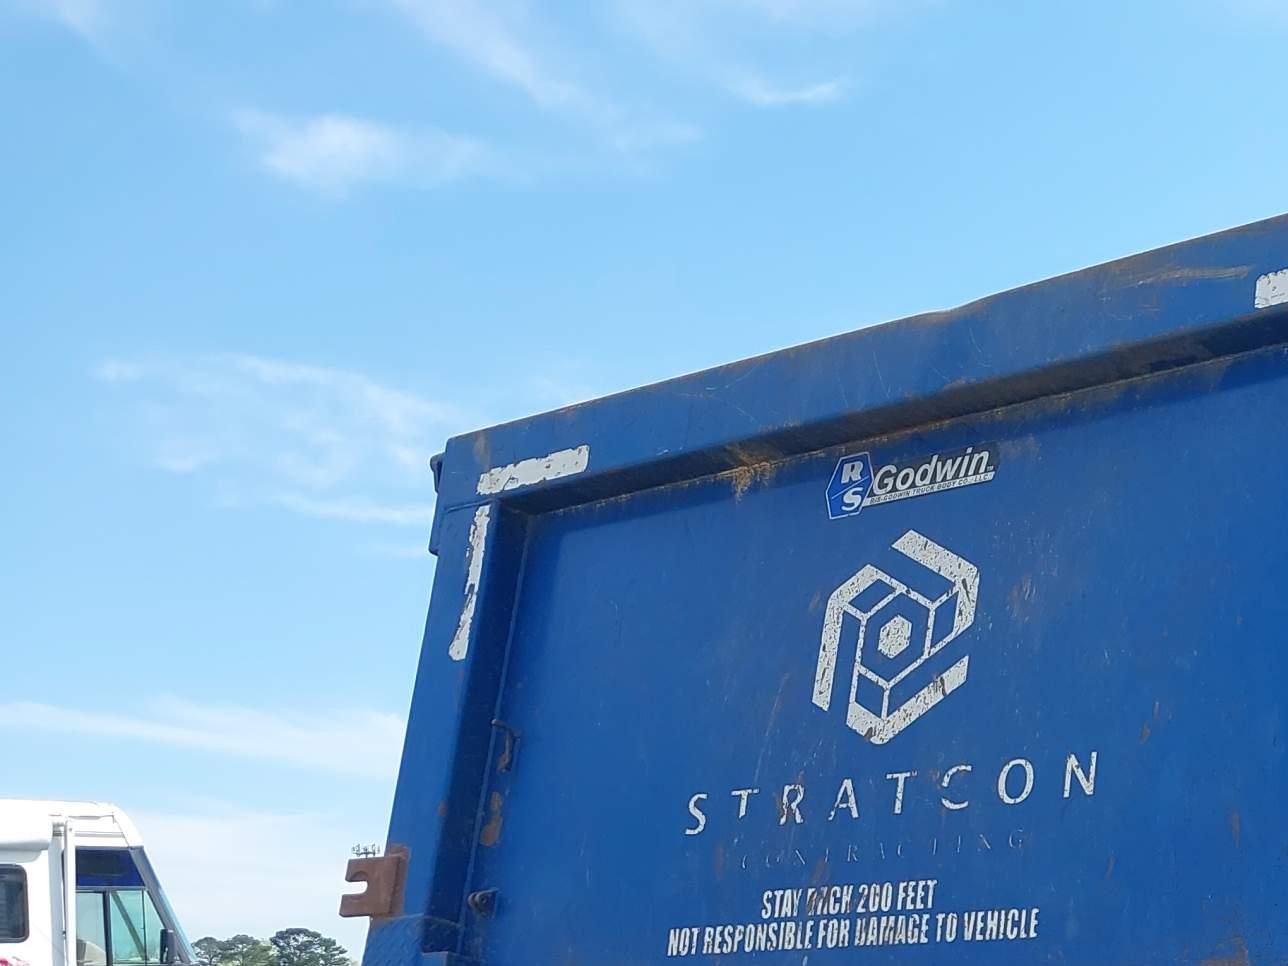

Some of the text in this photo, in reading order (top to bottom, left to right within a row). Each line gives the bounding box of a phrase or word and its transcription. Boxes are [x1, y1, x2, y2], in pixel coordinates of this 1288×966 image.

[841, 461, 864, 484] R
[872, 447, 990, 495] Godwin
[841, 486, 864, 511] S
[685, 752, 1098, 835] STRATCON
[761, 888, 803, 919] STAY
[856, 882, 893, 913] 200
[897, 879, 938, 911] FEET
[667, 908, 1040, 957] NOT RESPONSIBLE FOR DAMAGE TO VEHICLE
